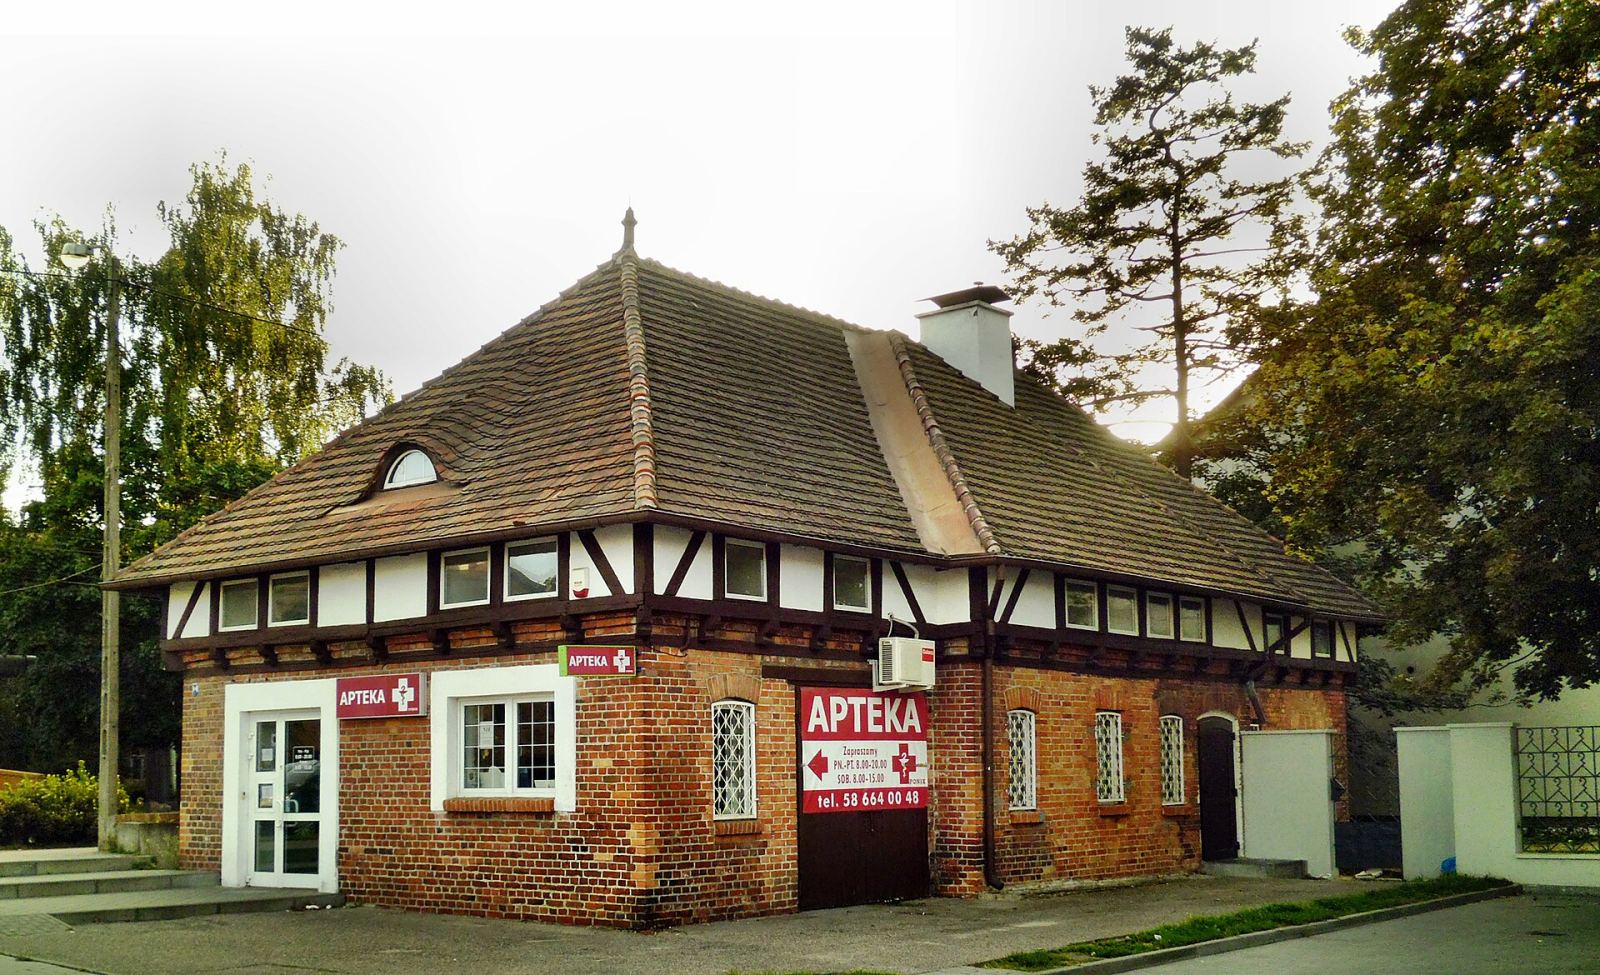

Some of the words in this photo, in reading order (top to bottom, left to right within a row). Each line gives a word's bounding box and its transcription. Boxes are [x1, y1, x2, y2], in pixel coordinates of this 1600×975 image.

[569, 655, 608, 667] APTEKA
[340, 689, 386, 706] APTEKA
[807, 695, 922, 733] APTEKA
[843, 746, 878, 757] Zapraszamy
[856, 759, 888, 769] 8.00-20.00
[837, 774, 851, 784] SOB.
[853, 773, 885, 783] 8.00-15.00
[817, 793, 839, 808] tel.
[843, 793, 858, 807] 58
[862, 792, 884, 806] 664
[887, 791, 902, 804] 00
[905, 790, 919, 803] 48
